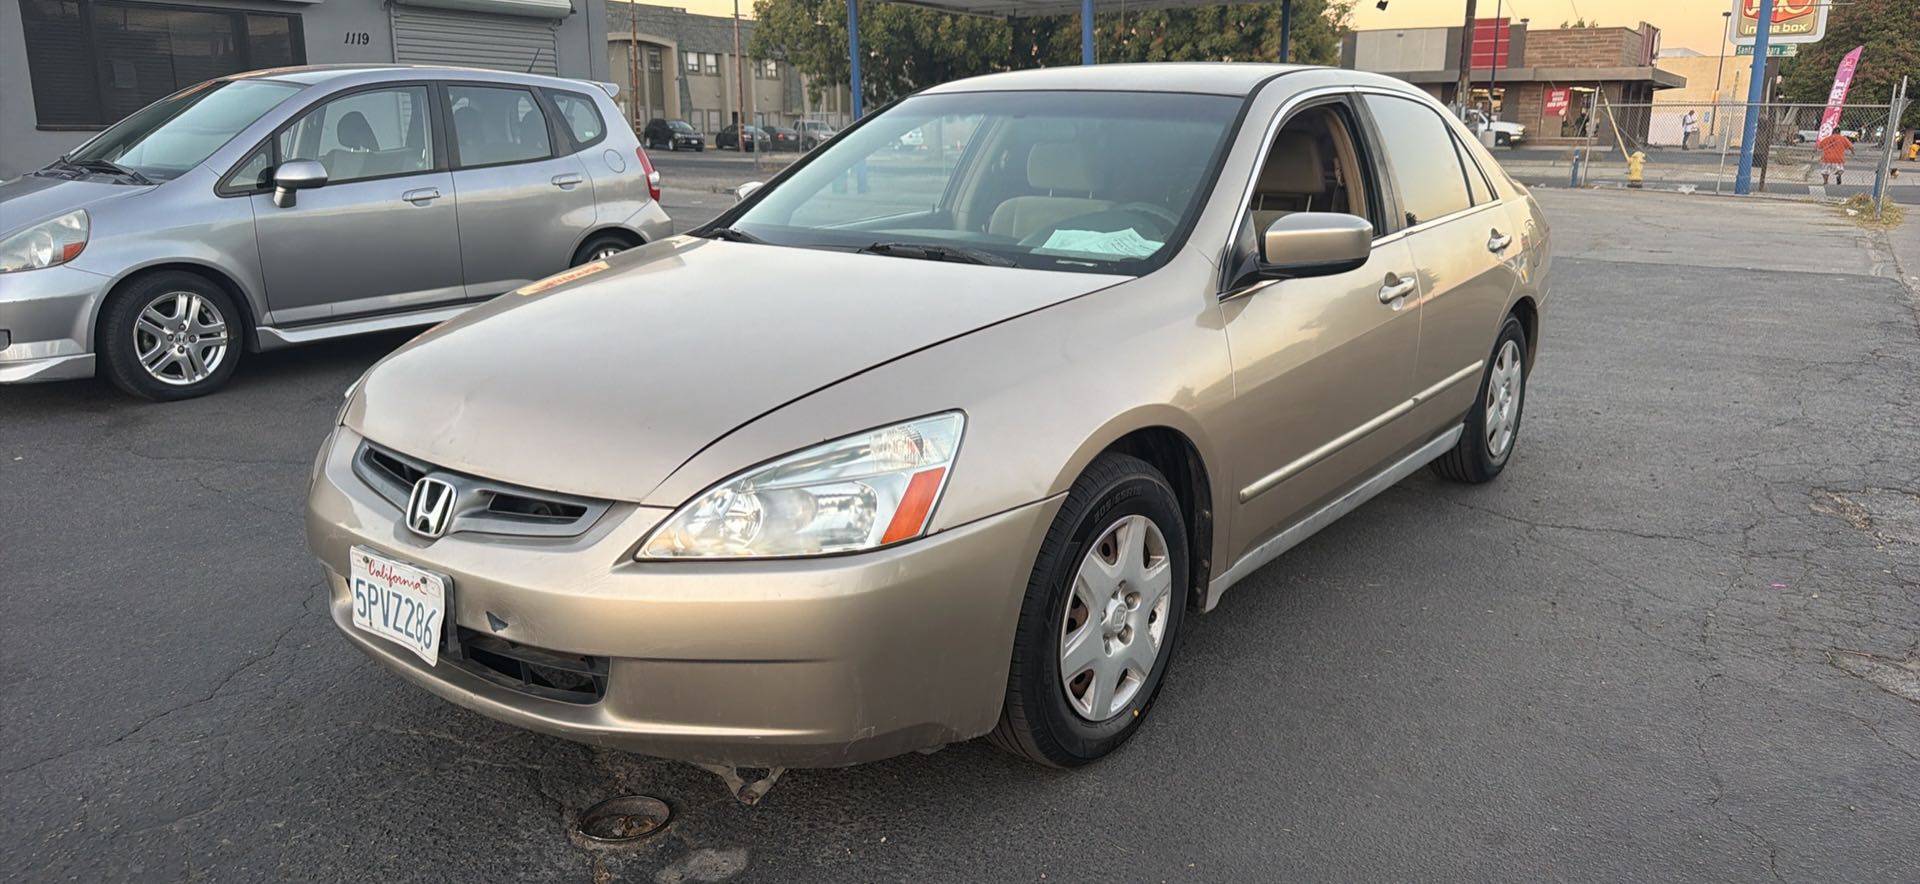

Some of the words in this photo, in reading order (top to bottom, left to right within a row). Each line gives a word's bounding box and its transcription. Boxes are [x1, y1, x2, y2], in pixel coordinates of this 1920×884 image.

[344, 32, 369, 45] 1119
[1783, 23, 1808, 33] box
[369, 560, 427, 595] California
[356, 578, 436, 649] 5PVZ286
